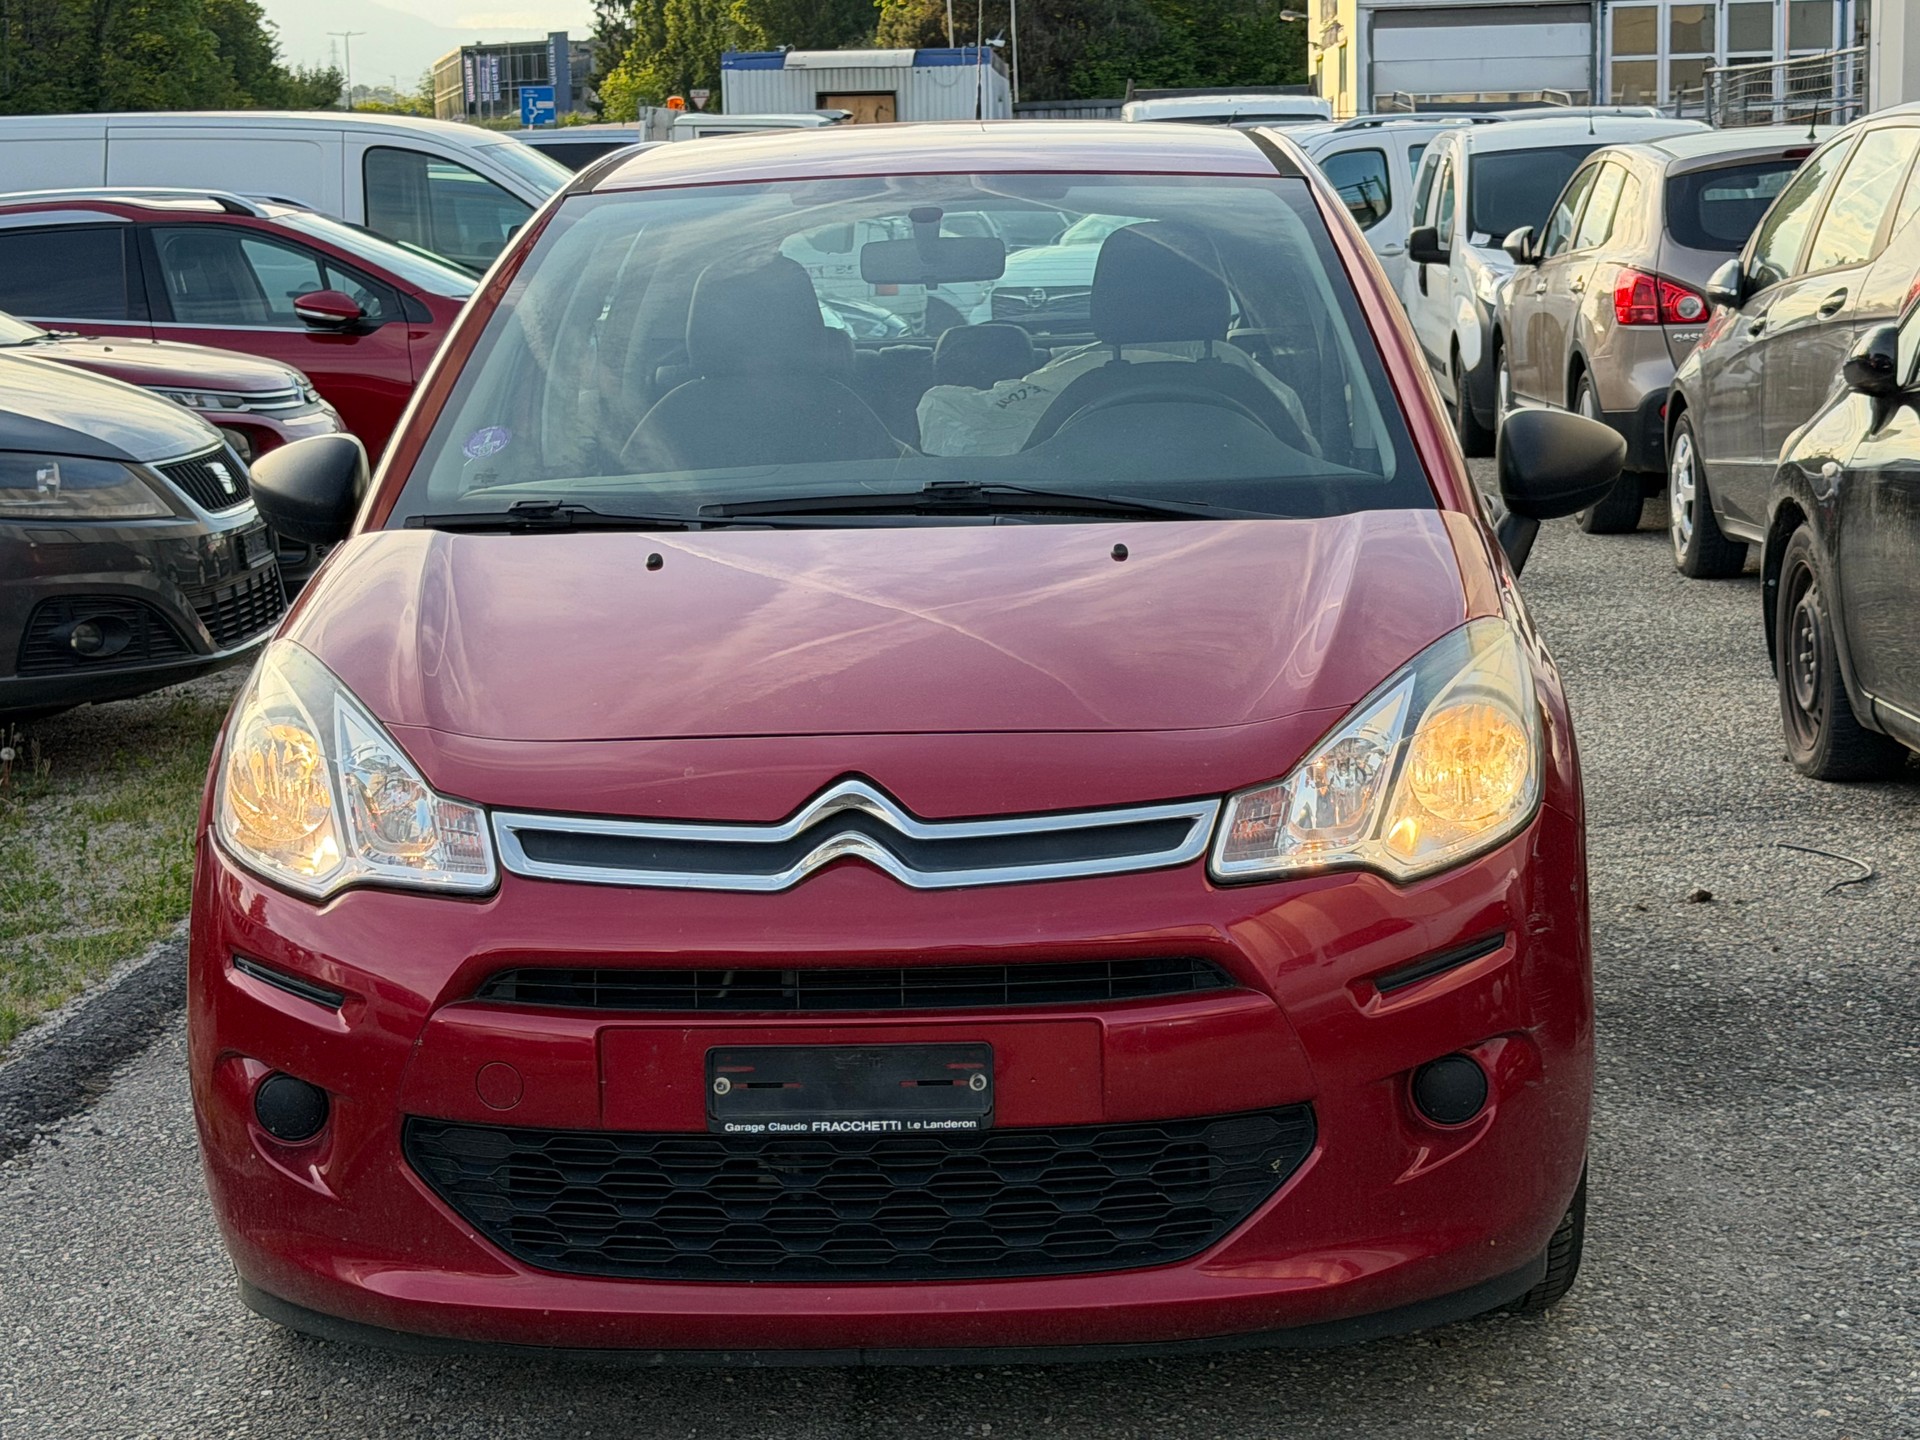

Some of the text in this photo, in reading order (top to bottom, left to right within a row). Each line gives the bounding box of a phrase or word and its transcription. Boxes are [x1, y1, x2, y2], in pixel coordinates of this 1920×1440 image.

[1672, 333, 1703, 342] QAS
[724, 1119, 977, 1133] Garage Claude FRACCHETTI Le Landeron
